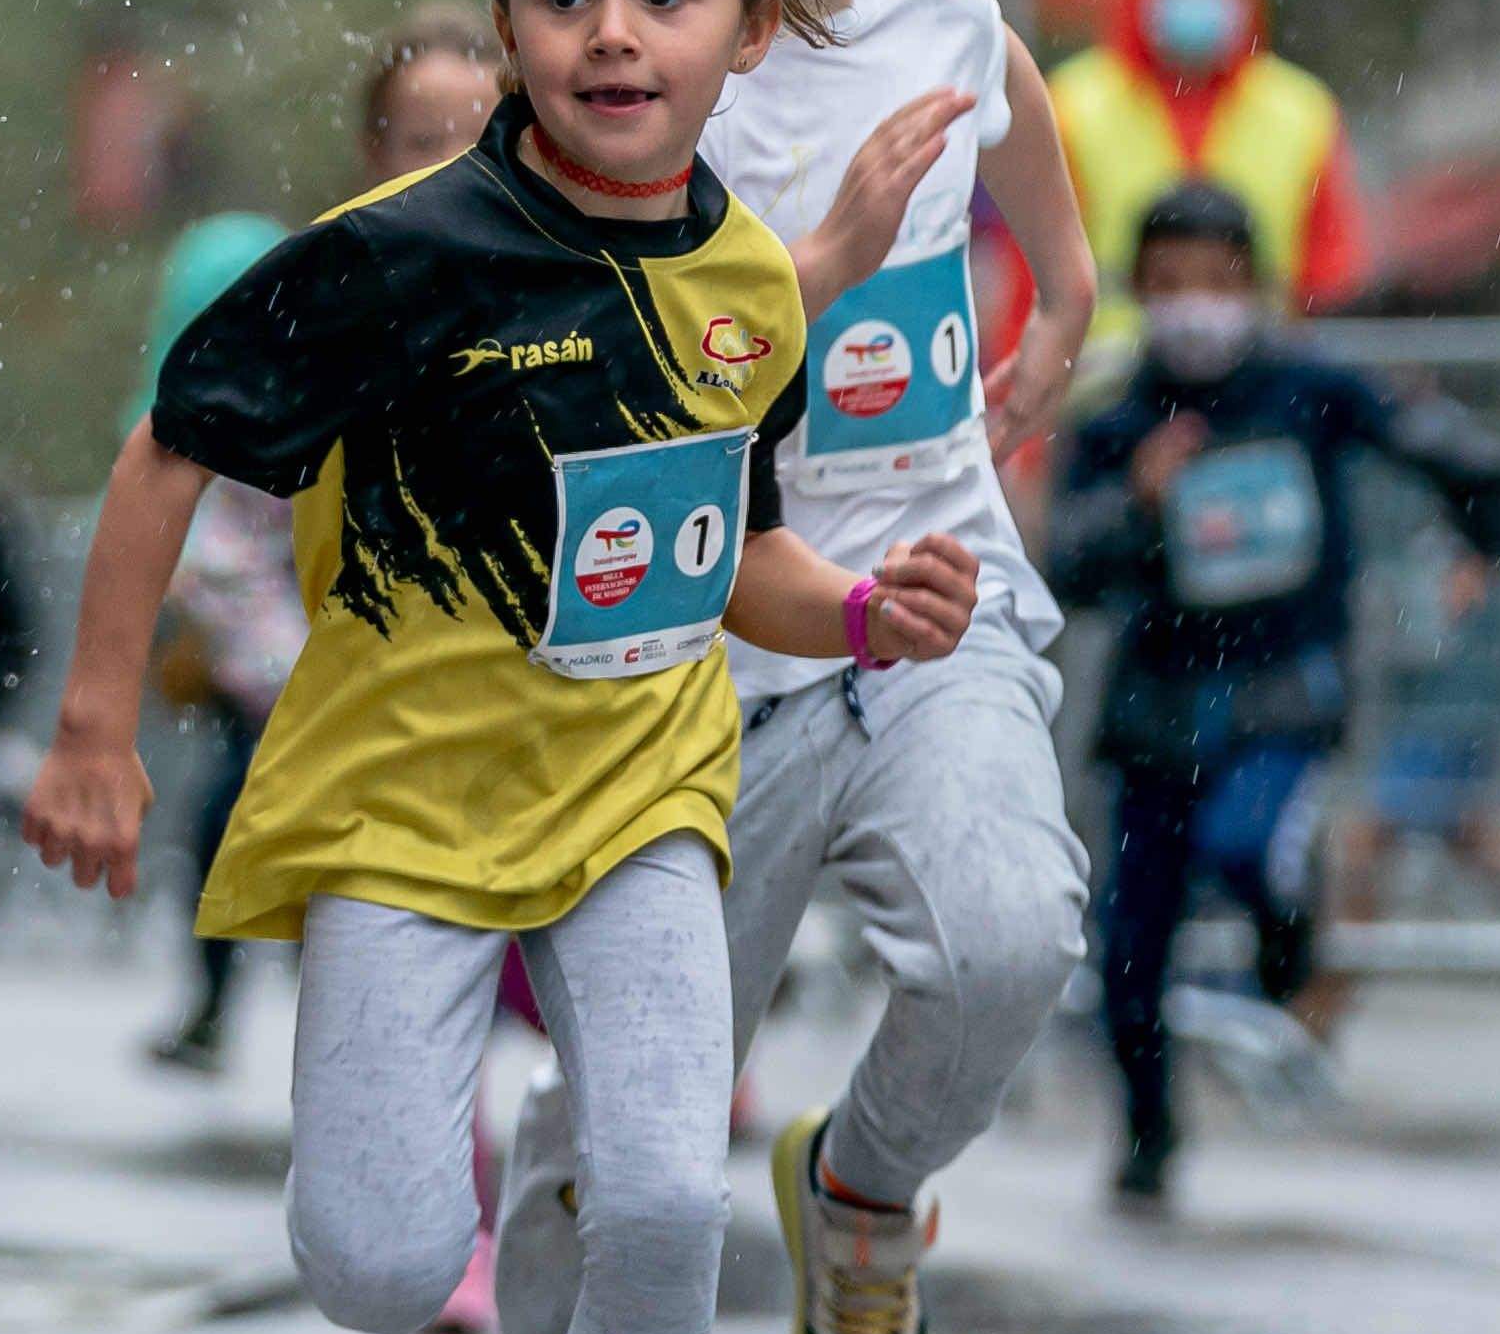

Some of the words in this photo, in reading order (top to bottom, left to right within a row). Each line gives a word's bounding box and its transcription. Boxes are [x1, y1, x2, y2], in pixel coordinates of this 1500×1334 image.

[510, 330, 594, 371] rasán
[944, 322, 957, 375] 1
[692, 514, 710, 566] 1
[568, 653, 614, 666] MADRID
